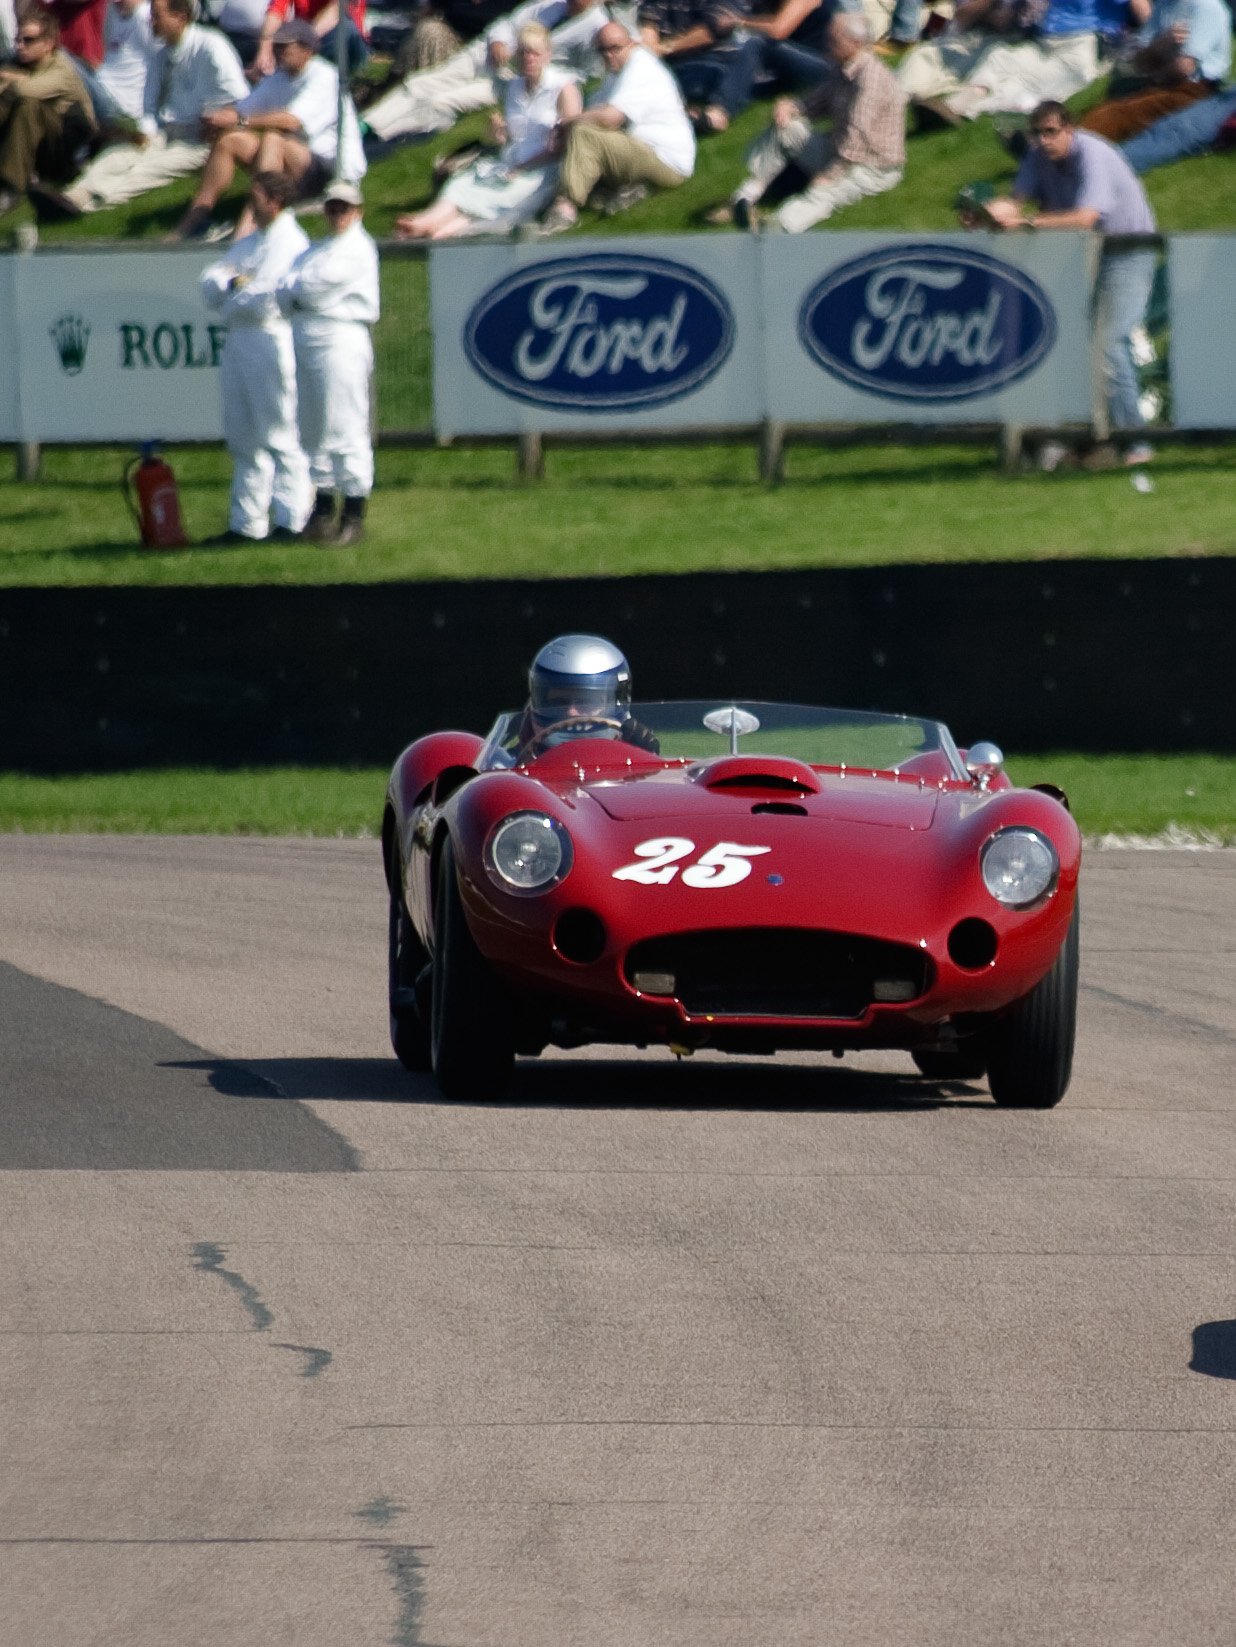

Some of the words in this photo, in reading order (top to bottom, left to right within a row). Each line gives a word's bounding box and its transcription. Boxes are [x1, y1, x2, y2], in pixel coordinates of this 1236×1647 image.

[120, 322, 230, 369] ROLE
[515, 273, 690, 381] Ford
[852, 264, 1004, 370] Ford
[611, 836, 772, 888] 25
